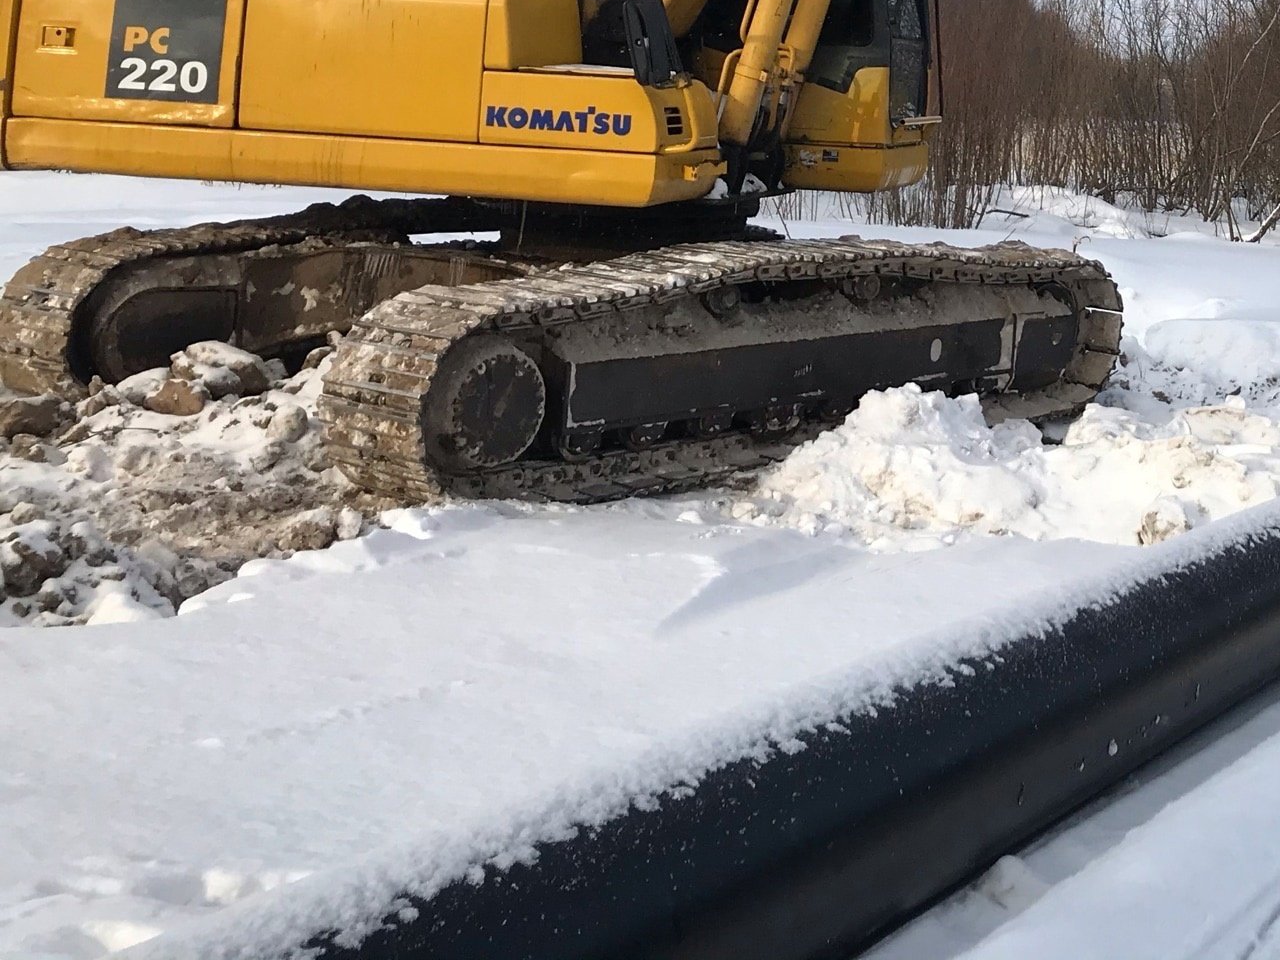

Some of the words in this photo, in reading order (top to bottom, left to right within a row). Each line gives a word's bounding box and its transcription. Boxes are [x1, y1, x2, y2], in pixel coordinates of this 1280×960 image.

[123, 26, 170, 55] PC
[117, 57, 208, 93] 220
[485, 105, 632, 136] KOMATSU
